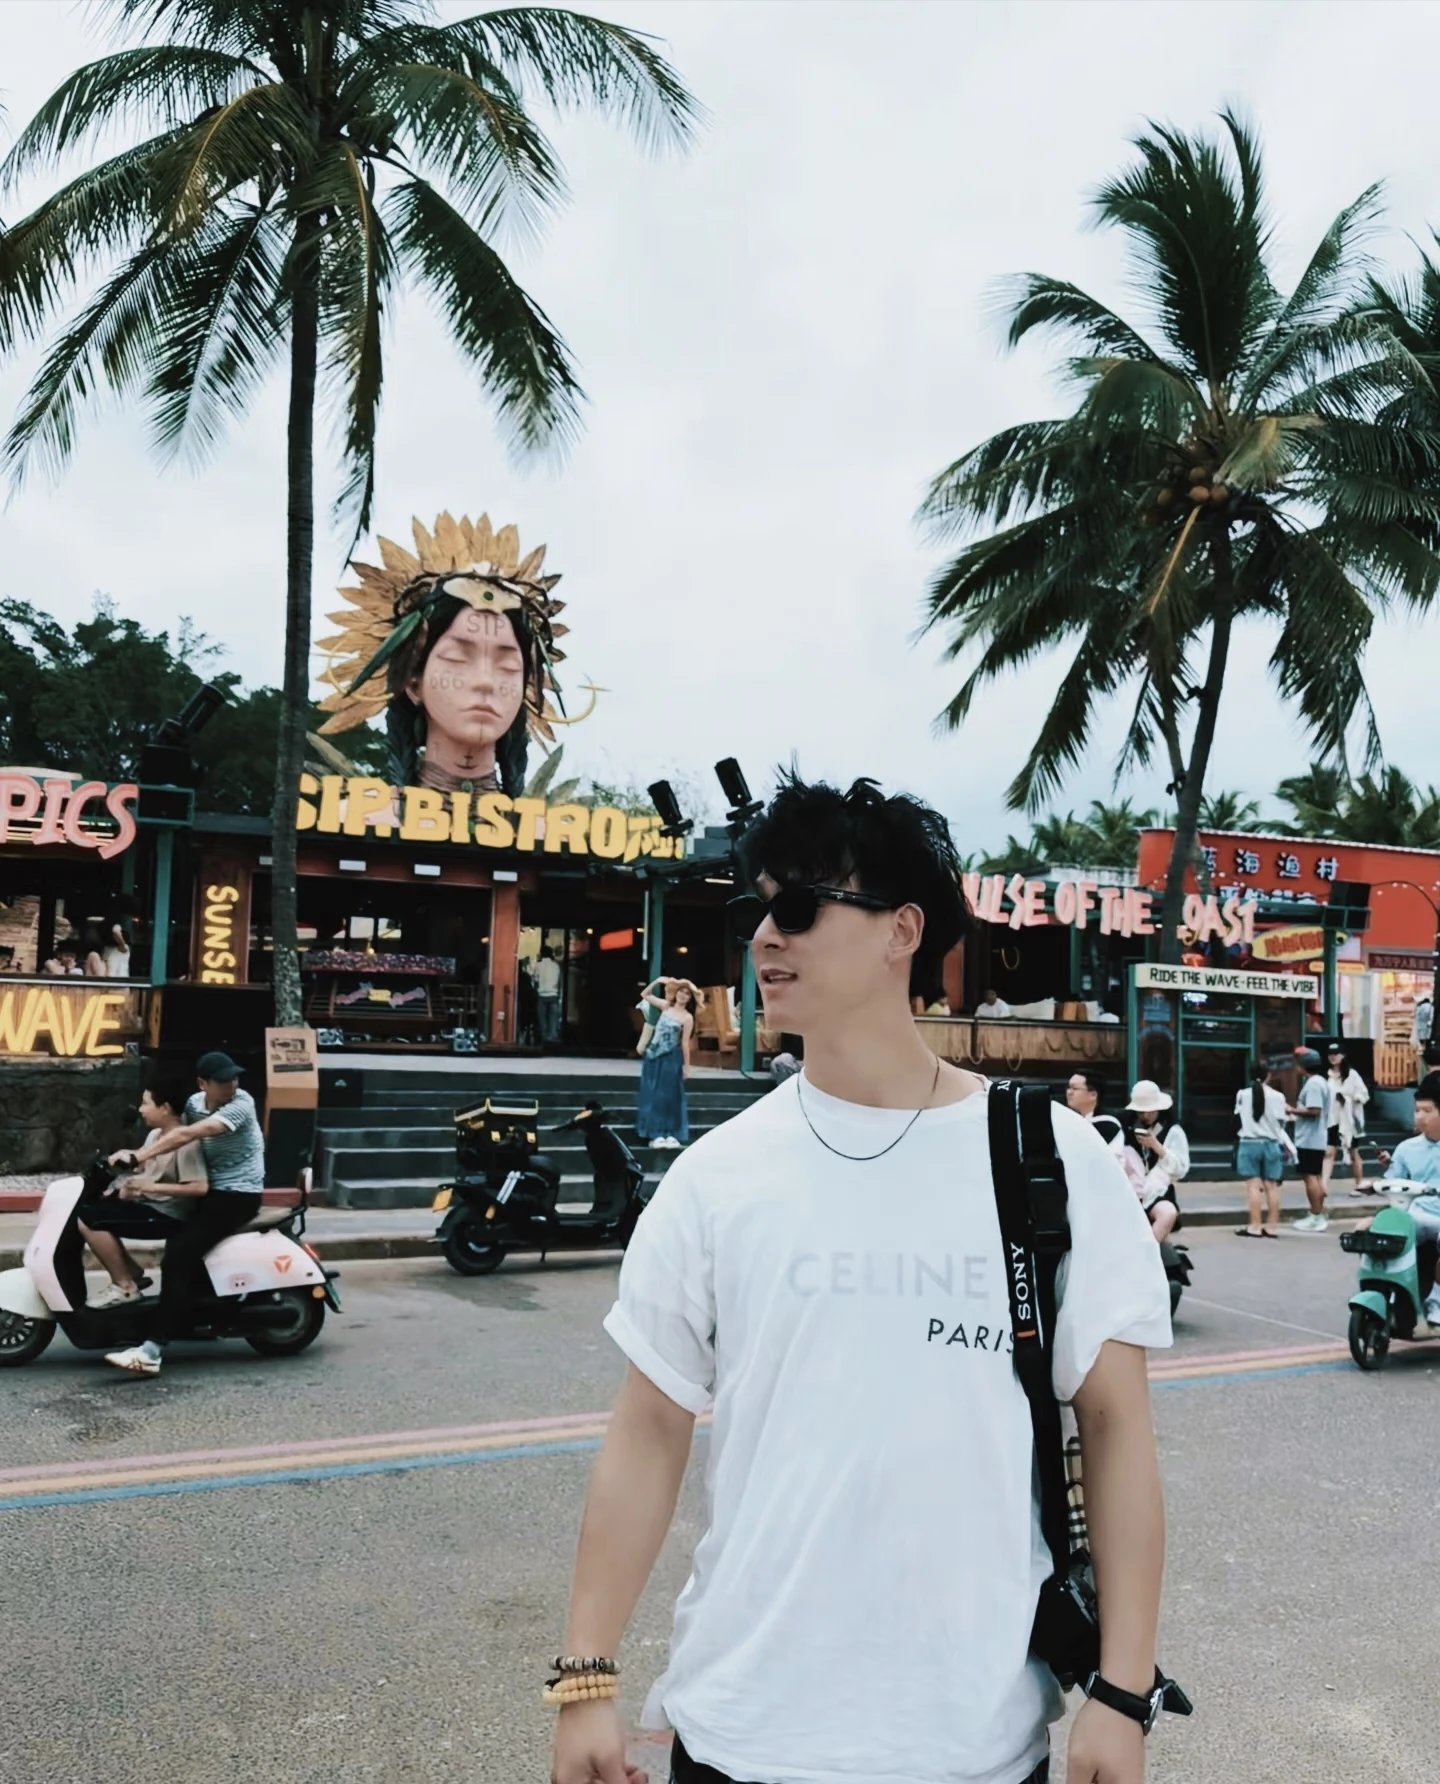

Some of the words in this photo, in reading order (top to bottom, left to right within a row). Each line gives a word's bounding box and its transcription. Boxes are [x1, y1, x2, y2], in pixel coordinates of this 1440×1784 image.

[0, 775, 139, 859] PICS
[202, 885, 239, 984] SUNSE
[962, 871, 1049, 931] ULSE
[1054, 880, 1098, 929] OF
[1099, 887, 1155, 938] THE
[1178, 893, 1258, 947] OAST
[1150, 967, 1177, 983] RIDE
[1181, 970, 1201, 985] THE
[1272, 978, 1289, 992] THE
[1291, 980, 1316, 993] VIBE
[0, 988, 126, 1055] WAVE
[787, 1251, 990, 1298] CELINE
[1010, 1242, 1031, 1321] SONY
